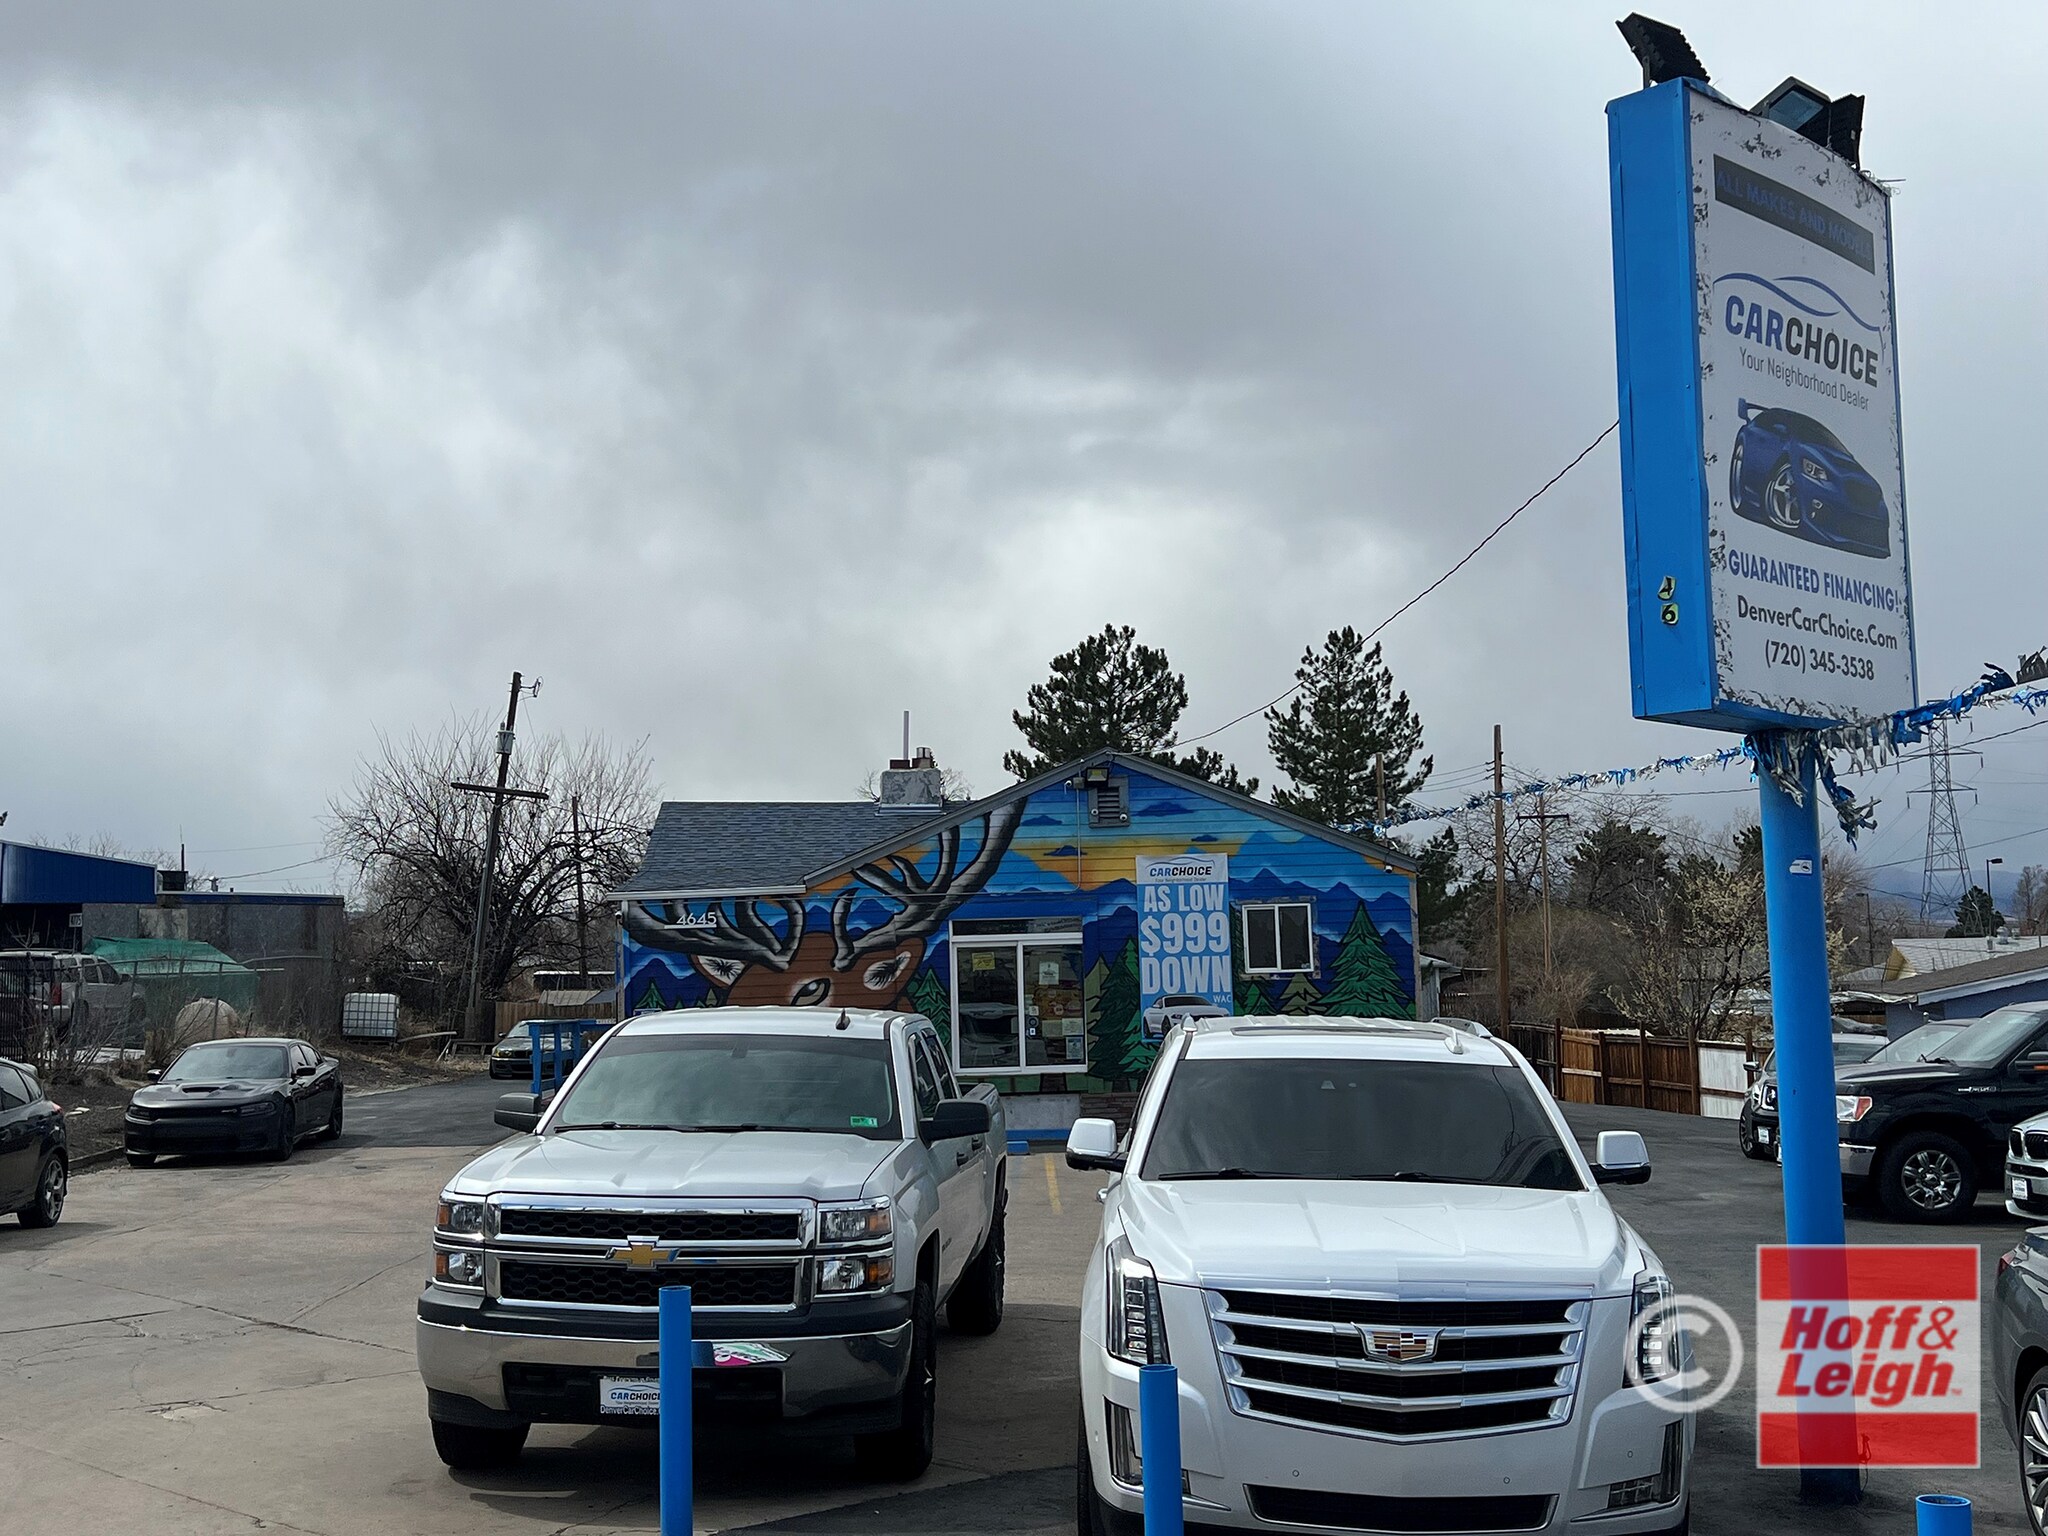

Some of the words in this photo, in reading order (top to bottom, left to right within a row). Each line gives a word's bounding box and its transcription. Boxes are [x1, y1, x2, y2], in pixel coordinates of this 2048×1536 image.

[1800, 207, 1826, 234] AND
[1725, 295, 1879, 388] CARCHOICE
[1739, 346, 1765, 372] Your
[1767, 358, 1837, 399] Neighborhood
[1840, 384, 1870, 411] Dealer
[1728, 549, 1819, 594] GUARANTEED
[1823, 571, 1899, 613] FINANCING!
[1737, 595, 1898, 650] DenverCarChoice.Com
[1765, 639, 1806, 674] (720)
[1809, 648, 1875, 680] 345-3538
[1149, 866, 1213, 877] CARCHOICE
[1143, 885, 1171, 912] AS
[1178, 884, 1224, 911] LOW
[676, 911, 717, 926] 4645
[1140, 912, 1230, 956] $999
[1141, 955, 1231, 994] DOWN
[1213, 995, 1232, 1003] WAC
